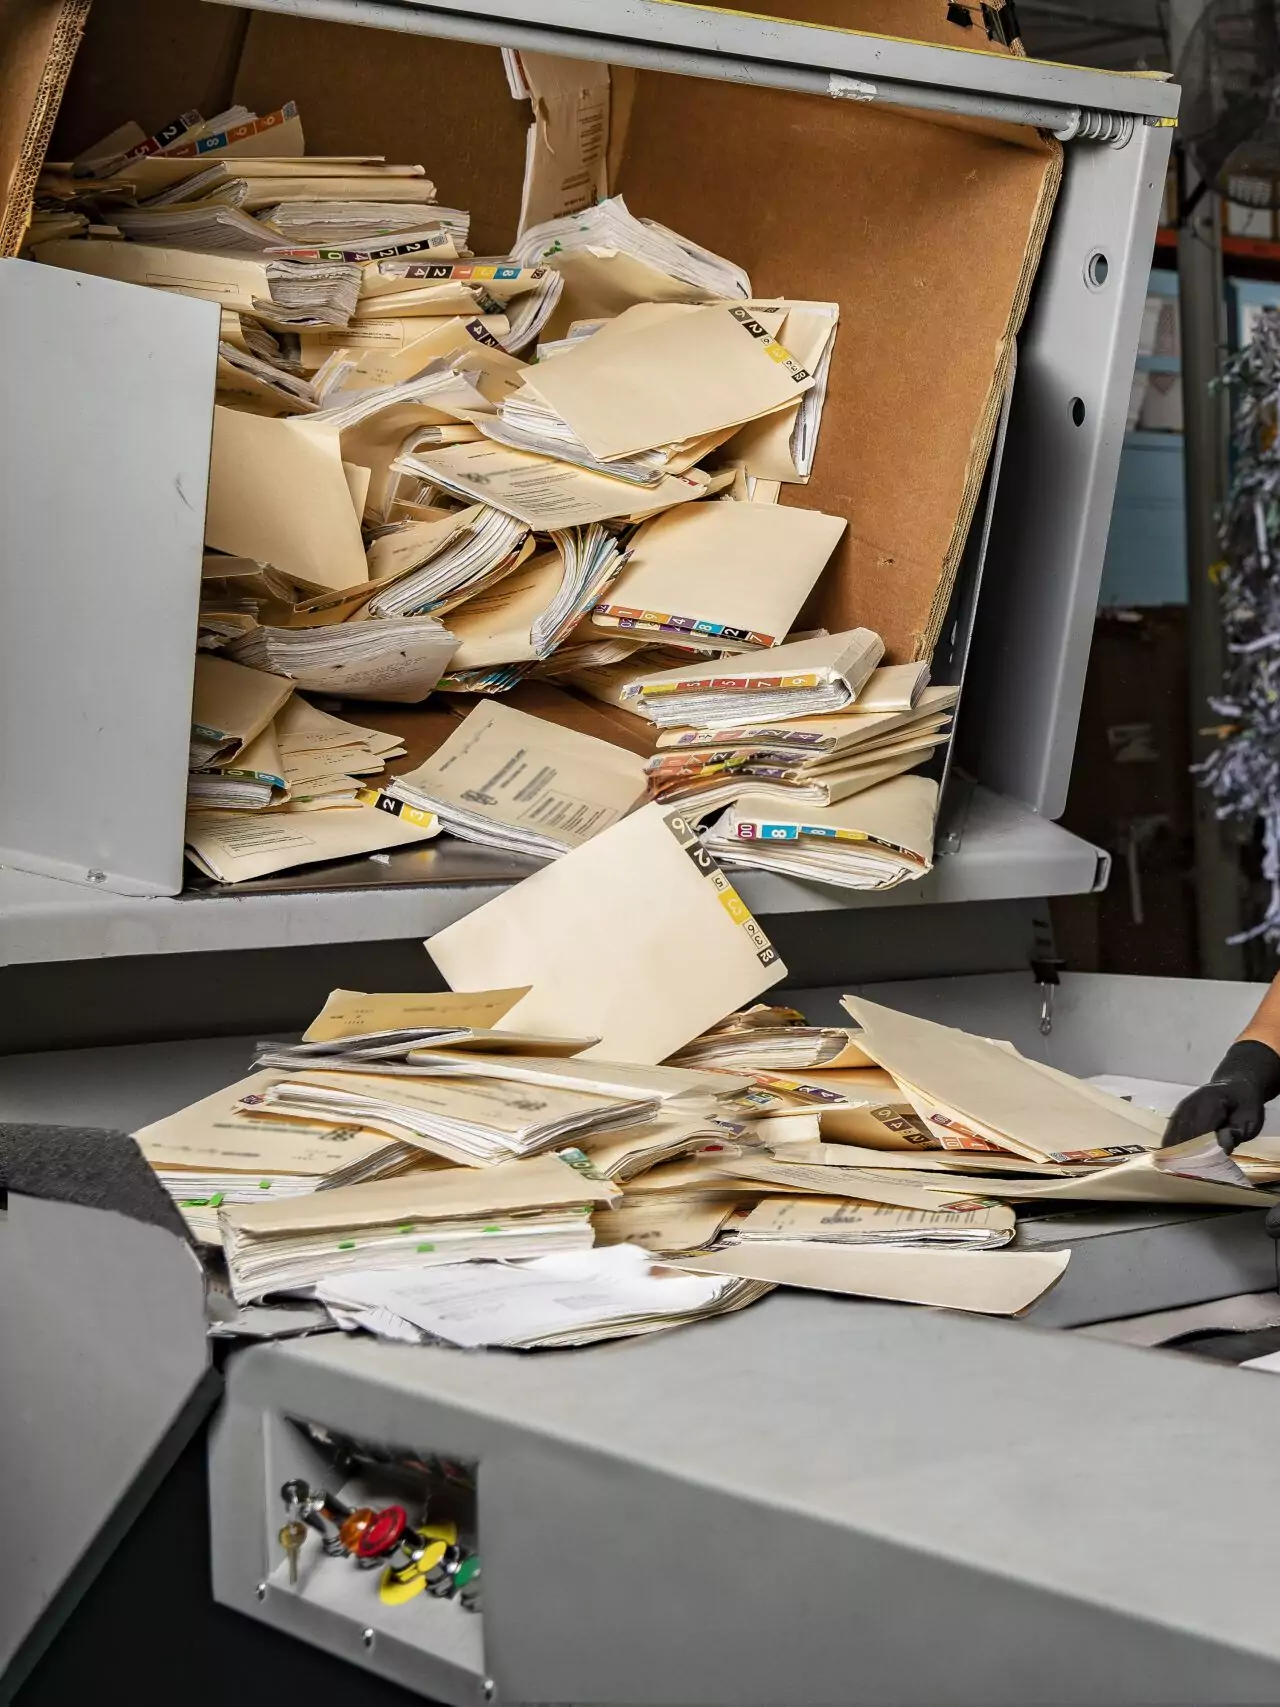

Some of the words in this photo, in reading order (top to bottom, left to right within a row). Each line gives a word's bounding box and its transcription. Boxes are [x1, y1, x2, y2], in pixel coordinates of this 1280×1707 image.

[162, 126, 178, 140] 2
[206, 137, 219, 147] 8
[406, 242, 421, 252] 2
[327, 252, 342, 260] 0
[379, 249, 394, 258] 2
[412, 268, 425, 276] 4
[433, 267, 447, 277] 2
[502, 268, 515, 277] 8
[734, 309, 746, 319] 6
[472, 325, 483, 335] 4
[749, 323, 763, 334] 2
[794, 371, 806, 381] 02
[672, 617, 686, 626] 4
[699, 623, 713, 632] 8
[724, 627, 740, 637] 2
[750, 633, 763, 643] 7
[382, 798, 396, 812] 2
[410, 809, 425, 822] 3
[671, 817, 686, 835] 6
[740, 823, 753, 837] 00
[771, 829, 787, 839] 8
[694, 848, 711, 867] 2
[715, 877, 724, 888] 5
[727, 899, 742, 916] 3
[747, 924, 757, 935] 6
[754, 935, 763, 945] 3
[762, 949, 774, 962] 02
